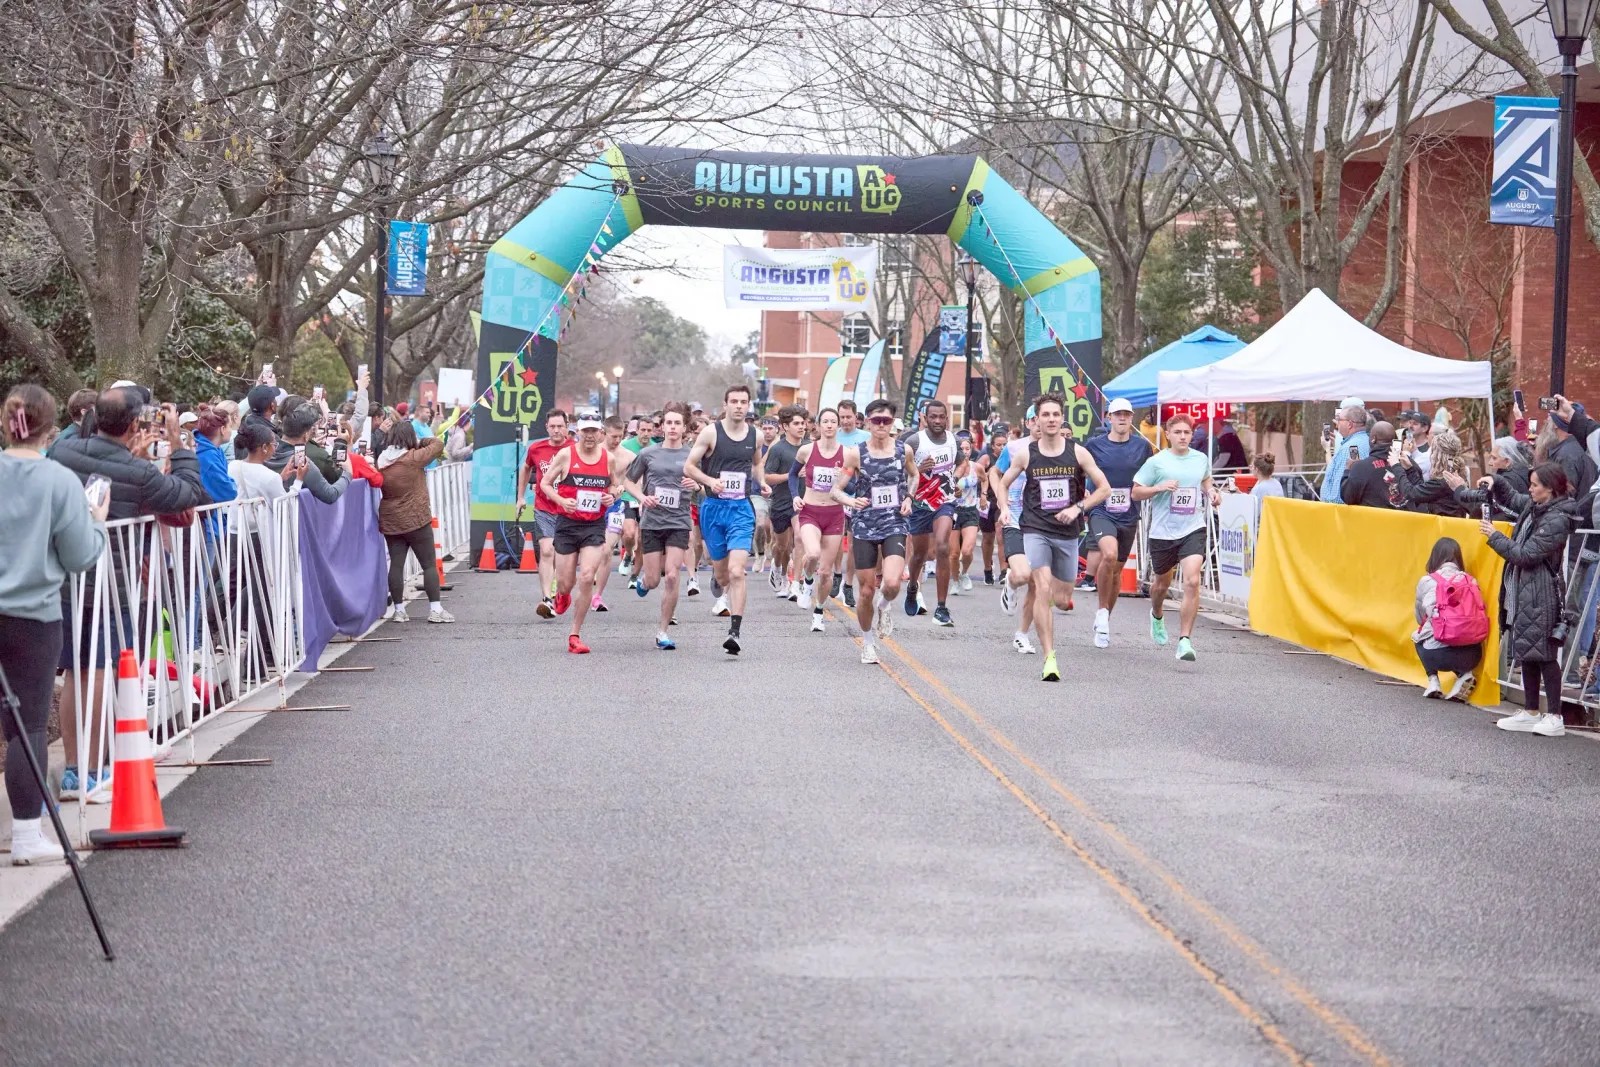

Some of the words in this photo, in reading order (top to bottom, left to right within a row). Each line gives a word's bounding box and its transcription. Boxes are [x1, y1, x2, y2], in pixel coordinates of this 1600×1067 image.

[694, 161, 853, 197] AUGUSTA
[694, 195, 766, 210] SPORTS
[773, 199, 853, 212] COUNCIL
[1505, 202, 1541, 210] AUGUSTA
[741, 265, 831, 285] AUGUSTA
[912, 351, 928, 393] SPORTS
[935, 454, 949, 464] 250
[817, 474, 832, 484] 233
[725, 480, 741, 490] 183
[1046, 488, 1064, 499] 328
[581, 498, 598, 509] 472
[659, 495, 675, 506] 210
[877, 494, 893, 505] 191
[1111, 495, 1126, 505] 532
[1176, 495, 1192, 506] 267
[1222, 529, 1243, 553] AUGUSTA
